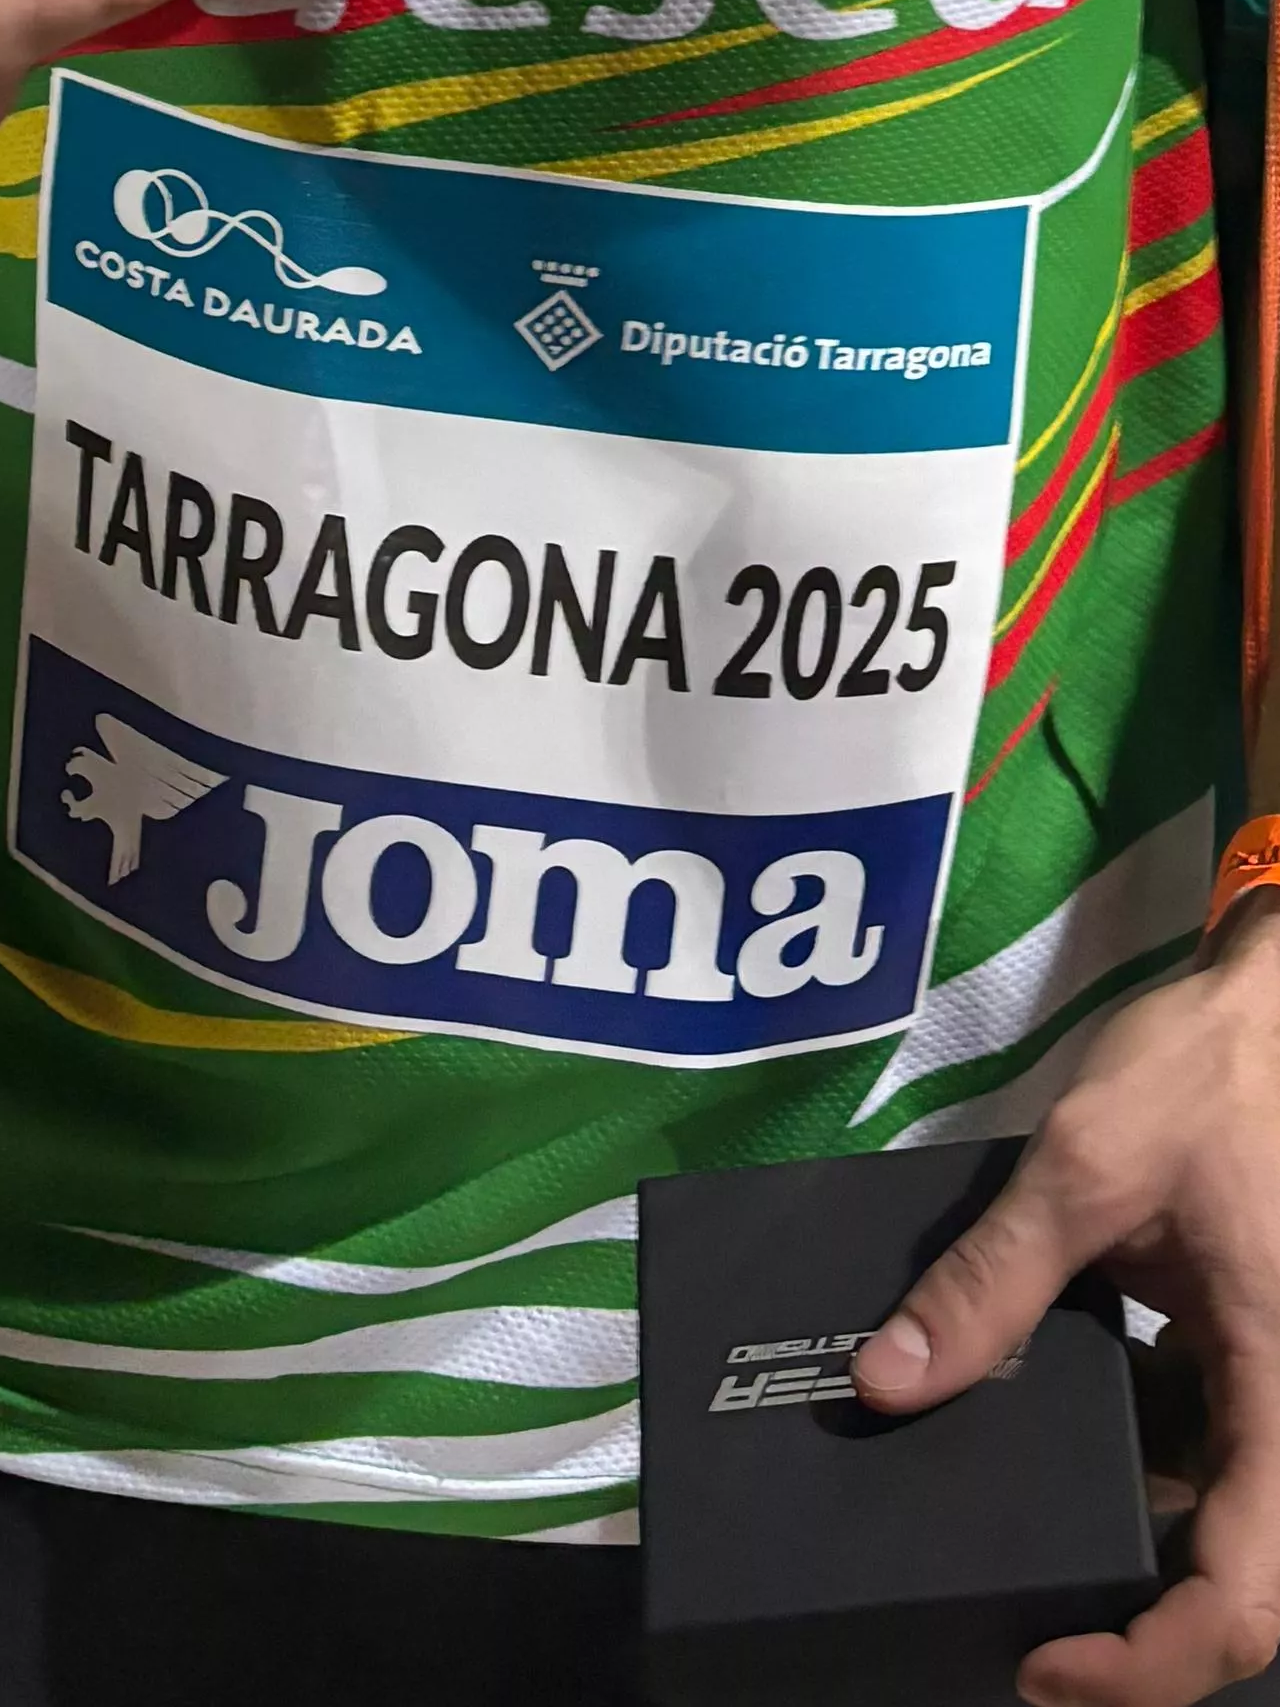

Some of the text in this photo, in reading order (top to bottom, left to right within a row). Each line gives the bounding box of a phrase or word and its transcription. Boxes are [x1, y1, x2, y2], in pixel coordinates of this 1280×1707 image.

[74, 239, 423, 355] COSTA DAURADA
[621, 319, 992, 380] Diputació Tarragona
[65, 419, 958, 701] TARRAGONA 2025
[707, 1366, 858, 1412] FEA
